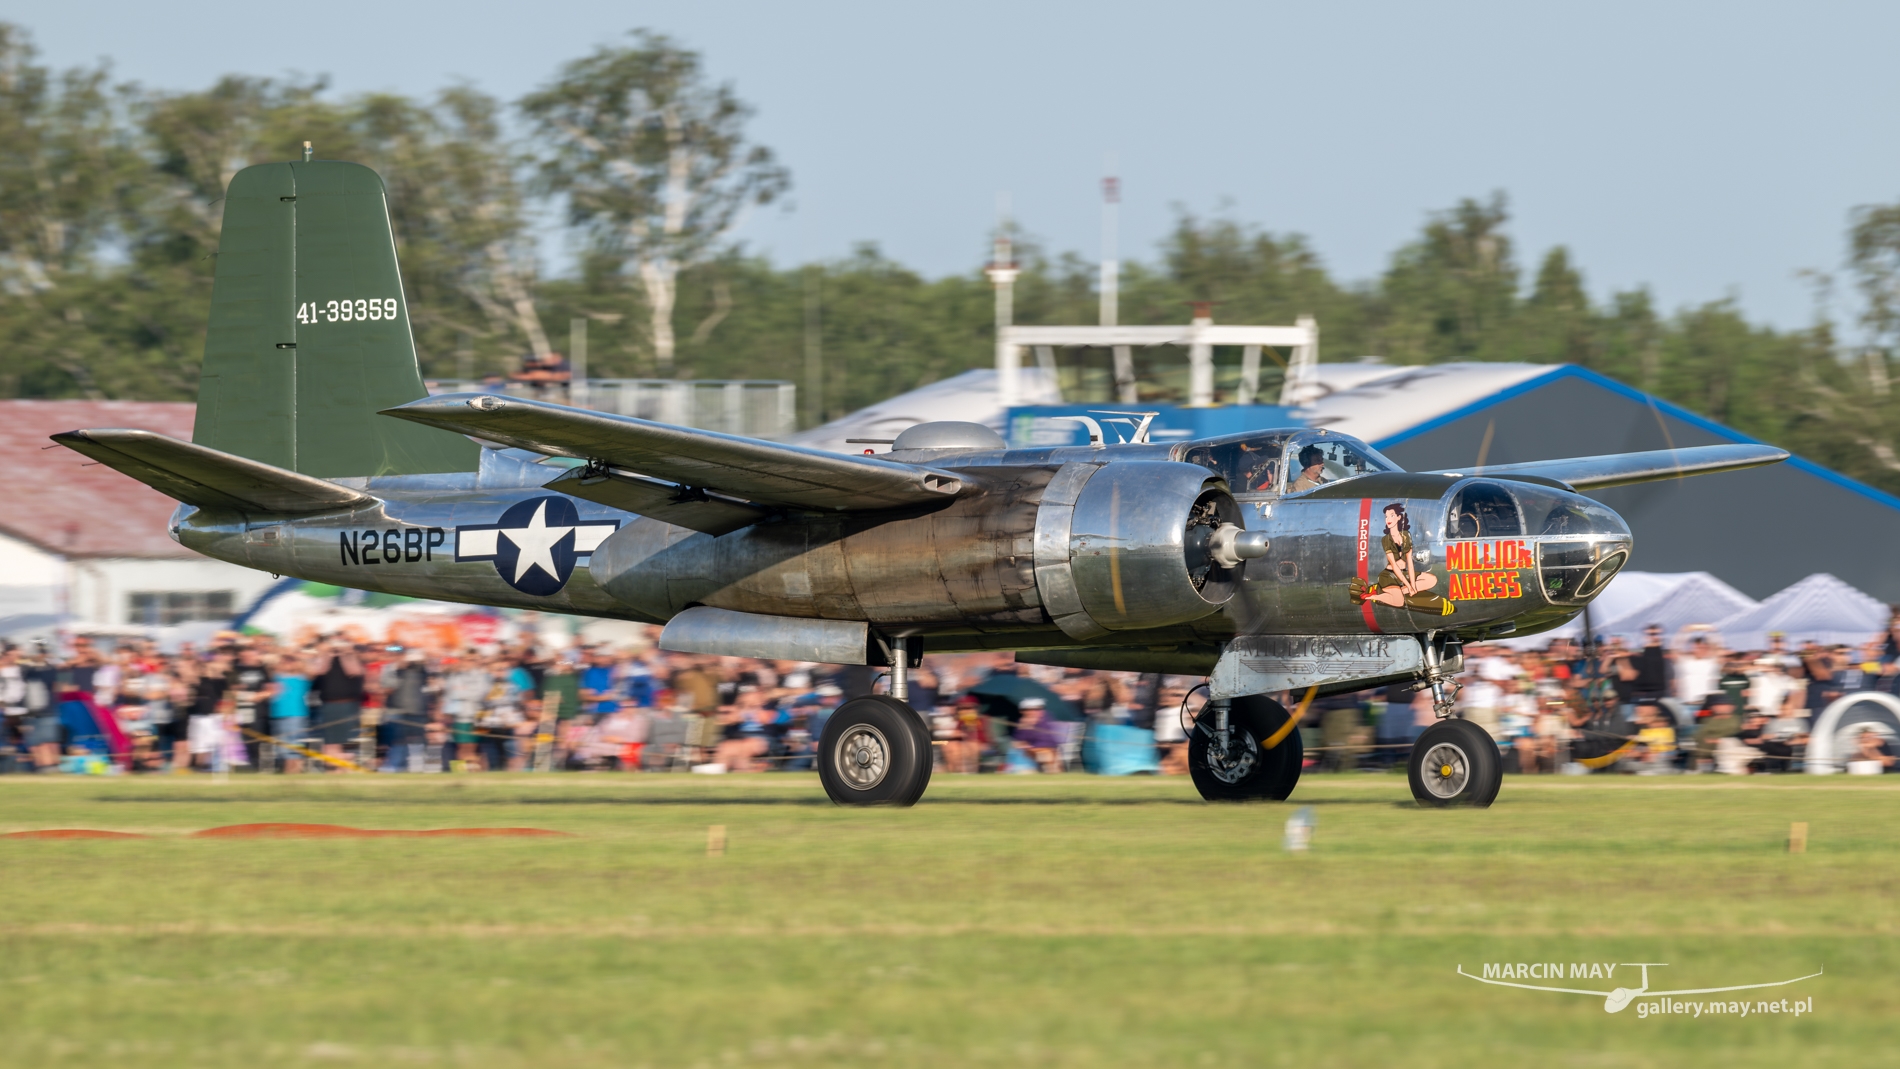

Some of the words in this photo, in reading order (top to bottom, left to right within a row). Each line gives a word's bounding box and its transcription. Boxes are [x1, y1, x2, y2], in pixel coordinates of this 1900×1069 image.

[296, 298, 397, 324] 41-39359
[340, 527, 445, 566] N26BP
[1359, 519, 1369, 561] PROP
[1449, 571, 1523, 601] AIRESS
[1350, 640, 1391, 658] AIR
